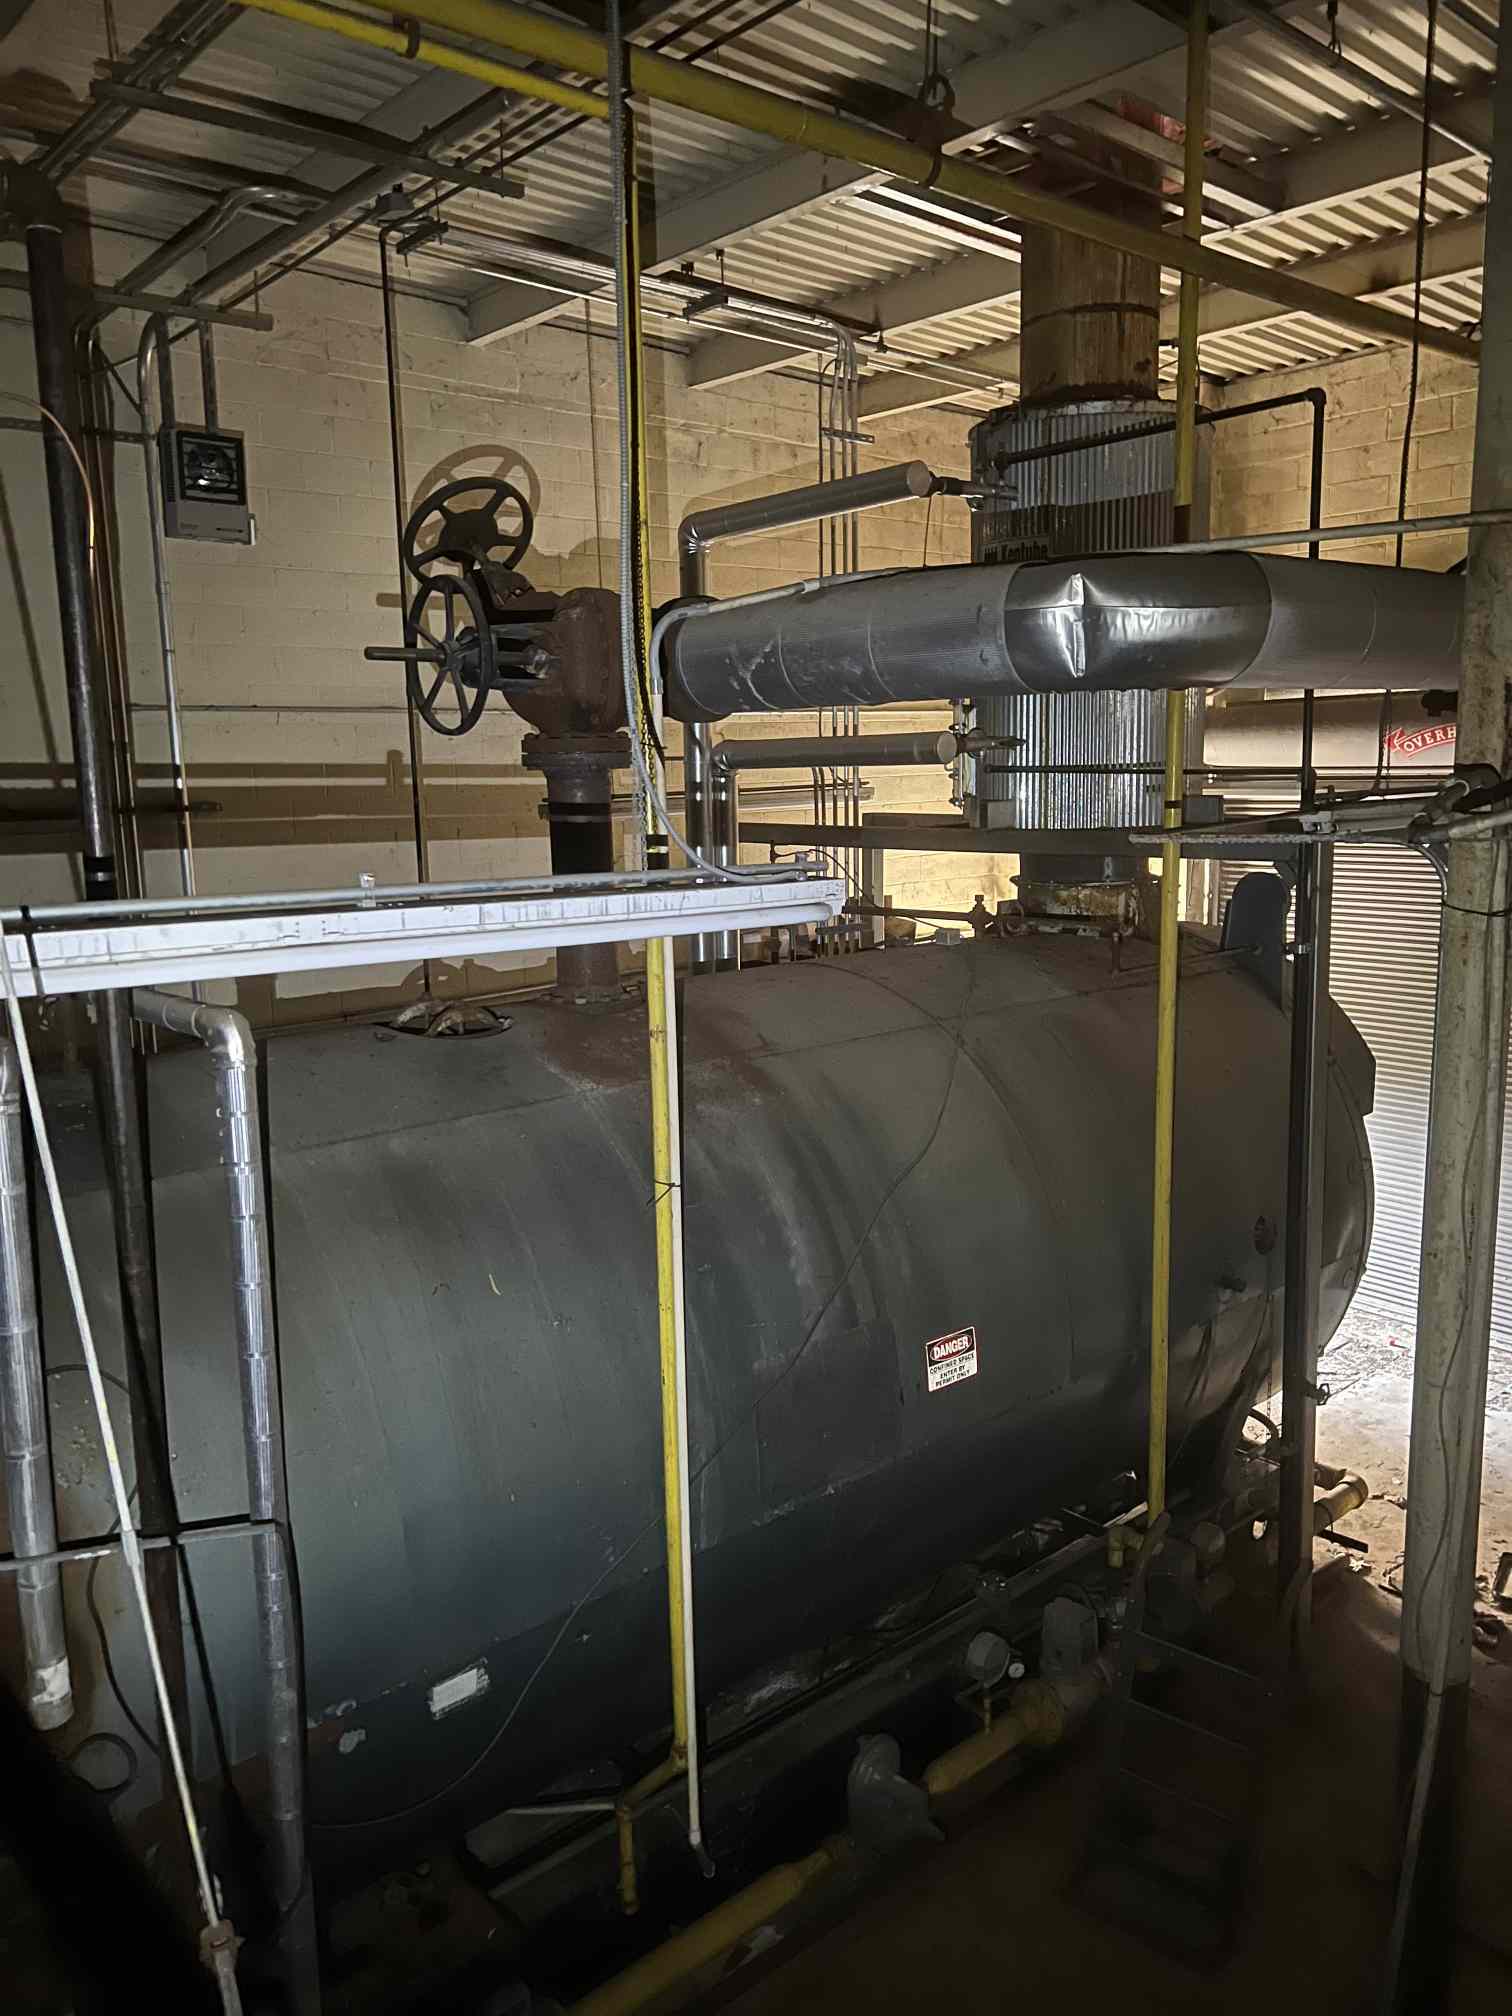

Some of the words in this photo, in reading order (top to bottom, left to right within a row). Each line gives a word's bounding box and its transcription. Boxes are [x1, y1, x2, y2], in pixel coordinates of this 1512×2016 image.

[933, 1336, 969, 1359] DANGER
[930, 1359, 957, 1374] CONFINED
[958, 1353, 975, 1363] SPACE
[936, 1376, 955, 1387] PERMIT
[957, 1369, 970, 1379] ONLY
[940, 1368, 958, 1379] ENTER
